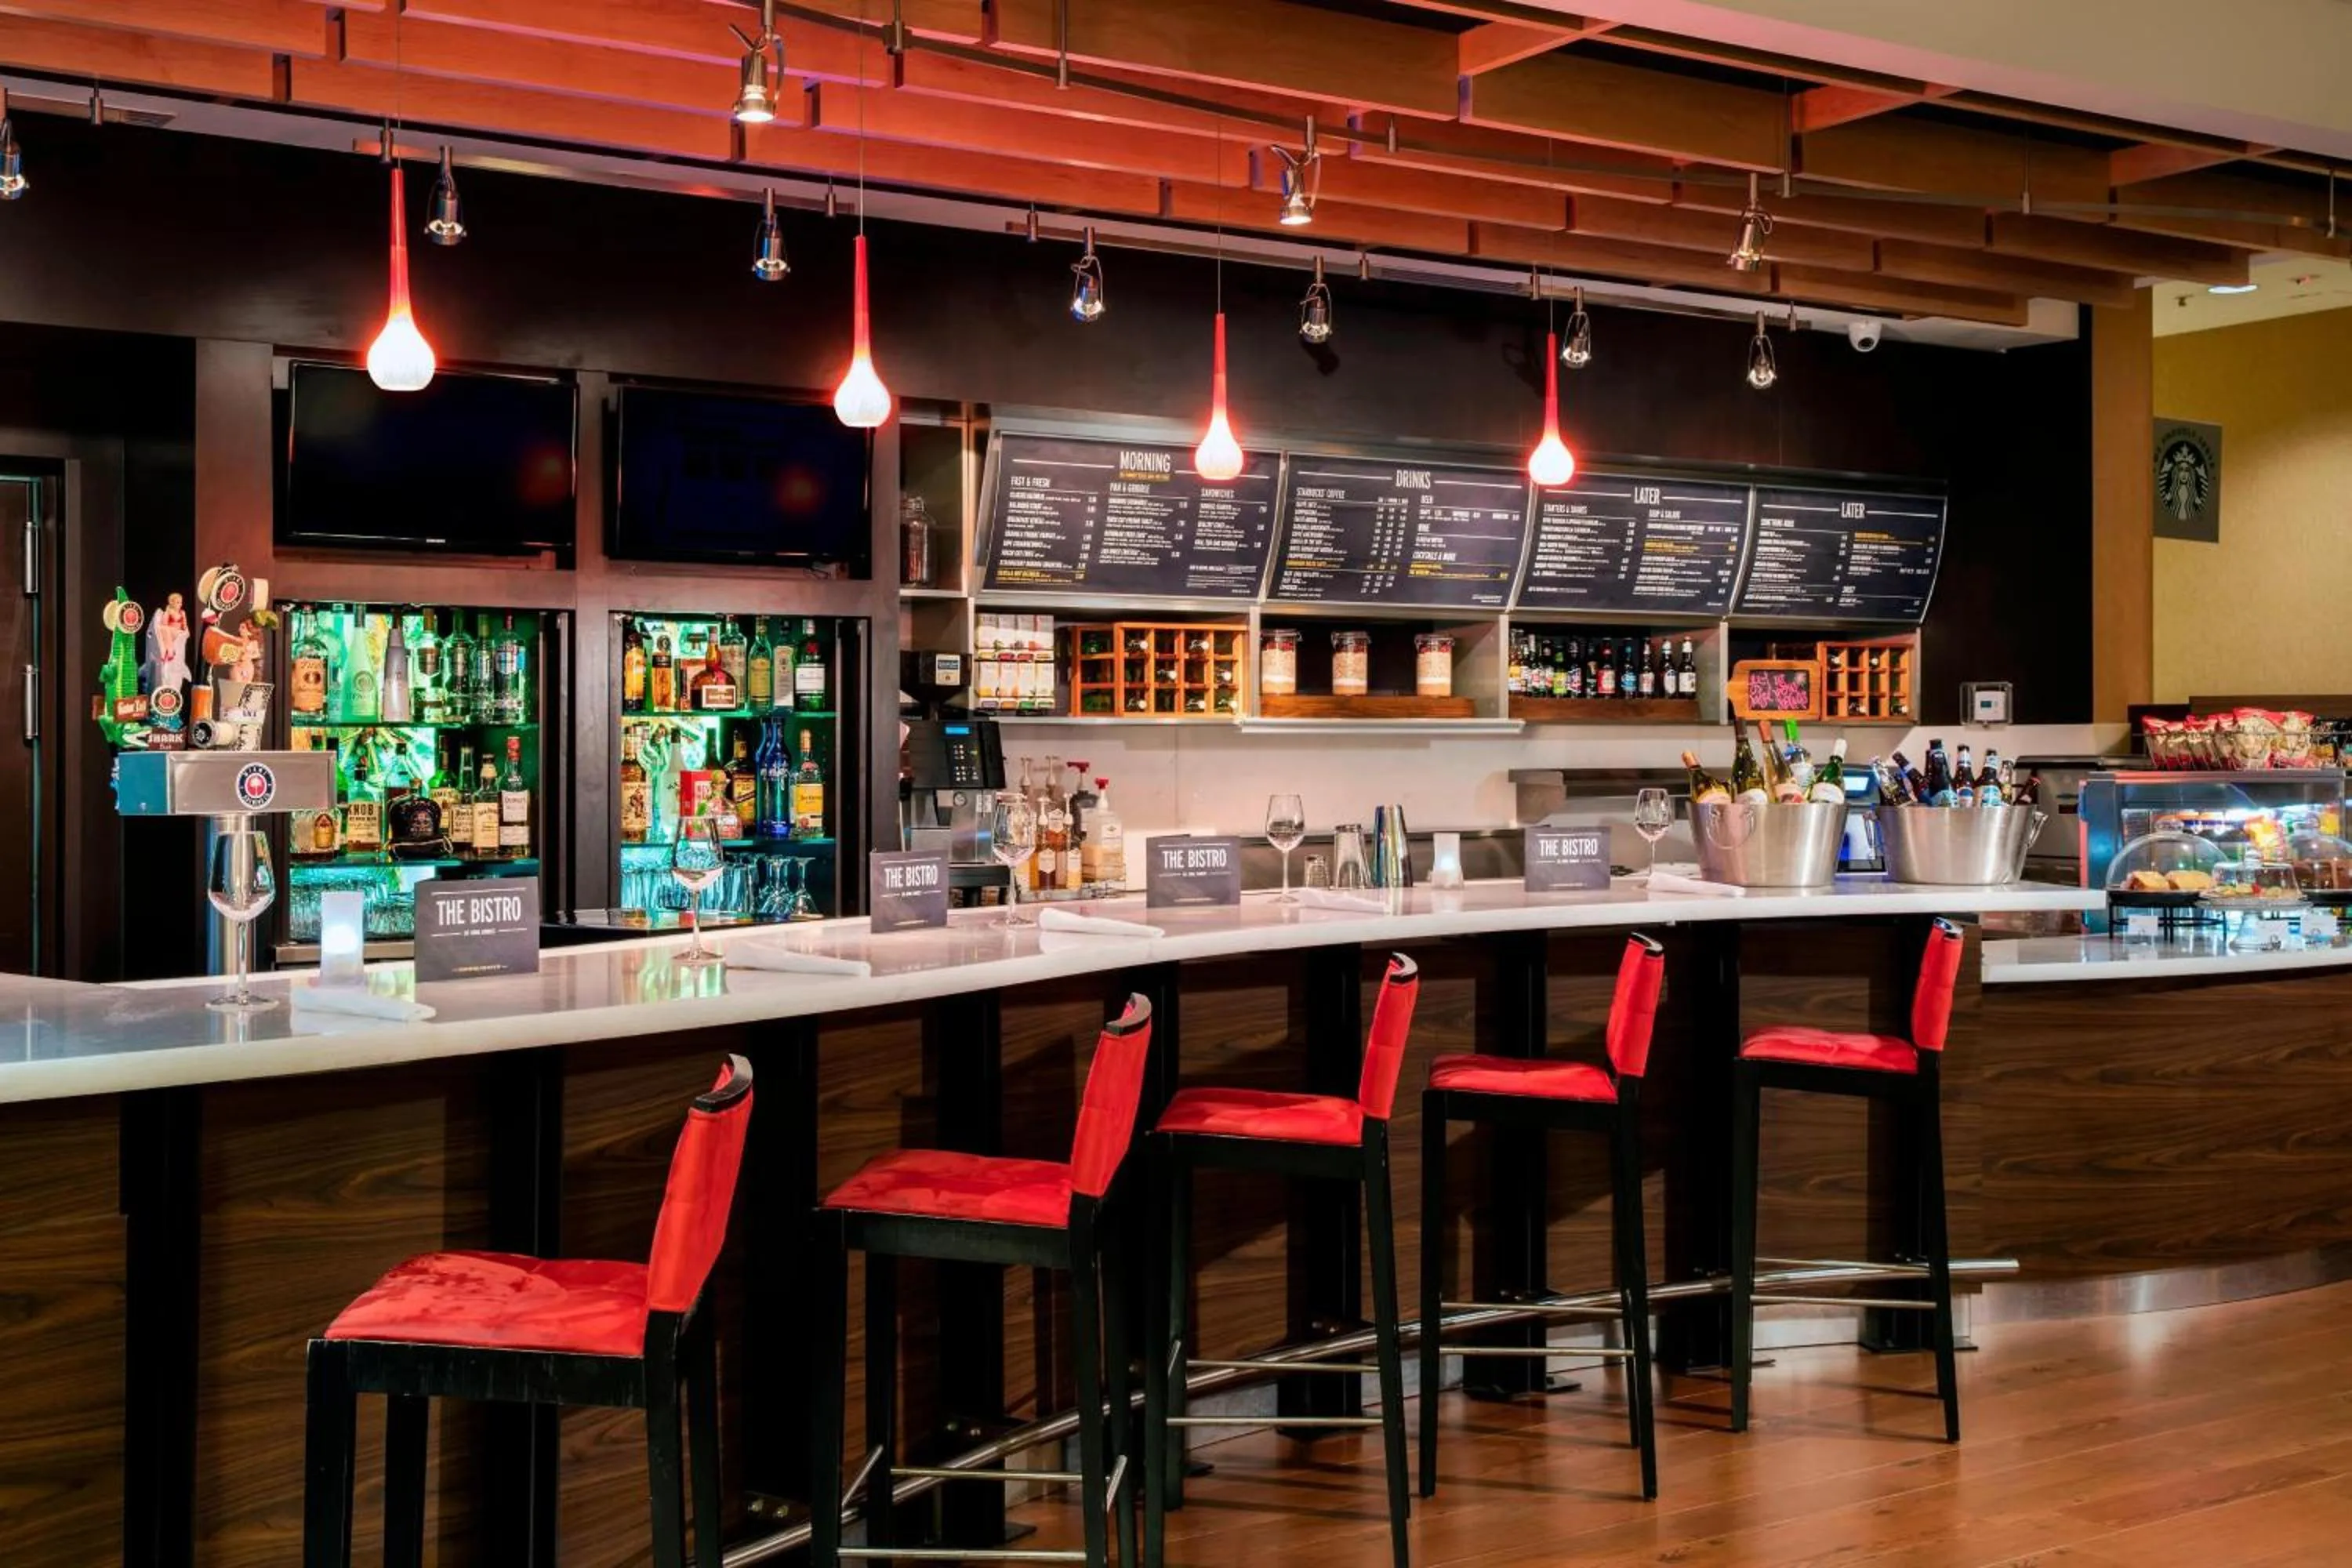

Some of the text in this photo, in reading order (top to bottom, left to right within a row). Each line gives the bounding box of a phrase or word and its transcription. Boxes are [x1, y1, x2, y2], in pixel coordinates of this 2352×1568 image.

[1120, 451, 1171, 473] MORNING
[1396, 470, 1431, 489] DRINKS
[1635, 487, 1661, 505] LATER
[1841, 502, 1866, 518] LATER
[148, 733, 183, 743] SHARK
[1539, 838, 1598, 856] THE BISTRO
[1162, 848, 1227, 869] THE BISTRO
[884, 864, 938, 888] THE BISTRO
[436, 896, 521, 925] THE BISTRO
